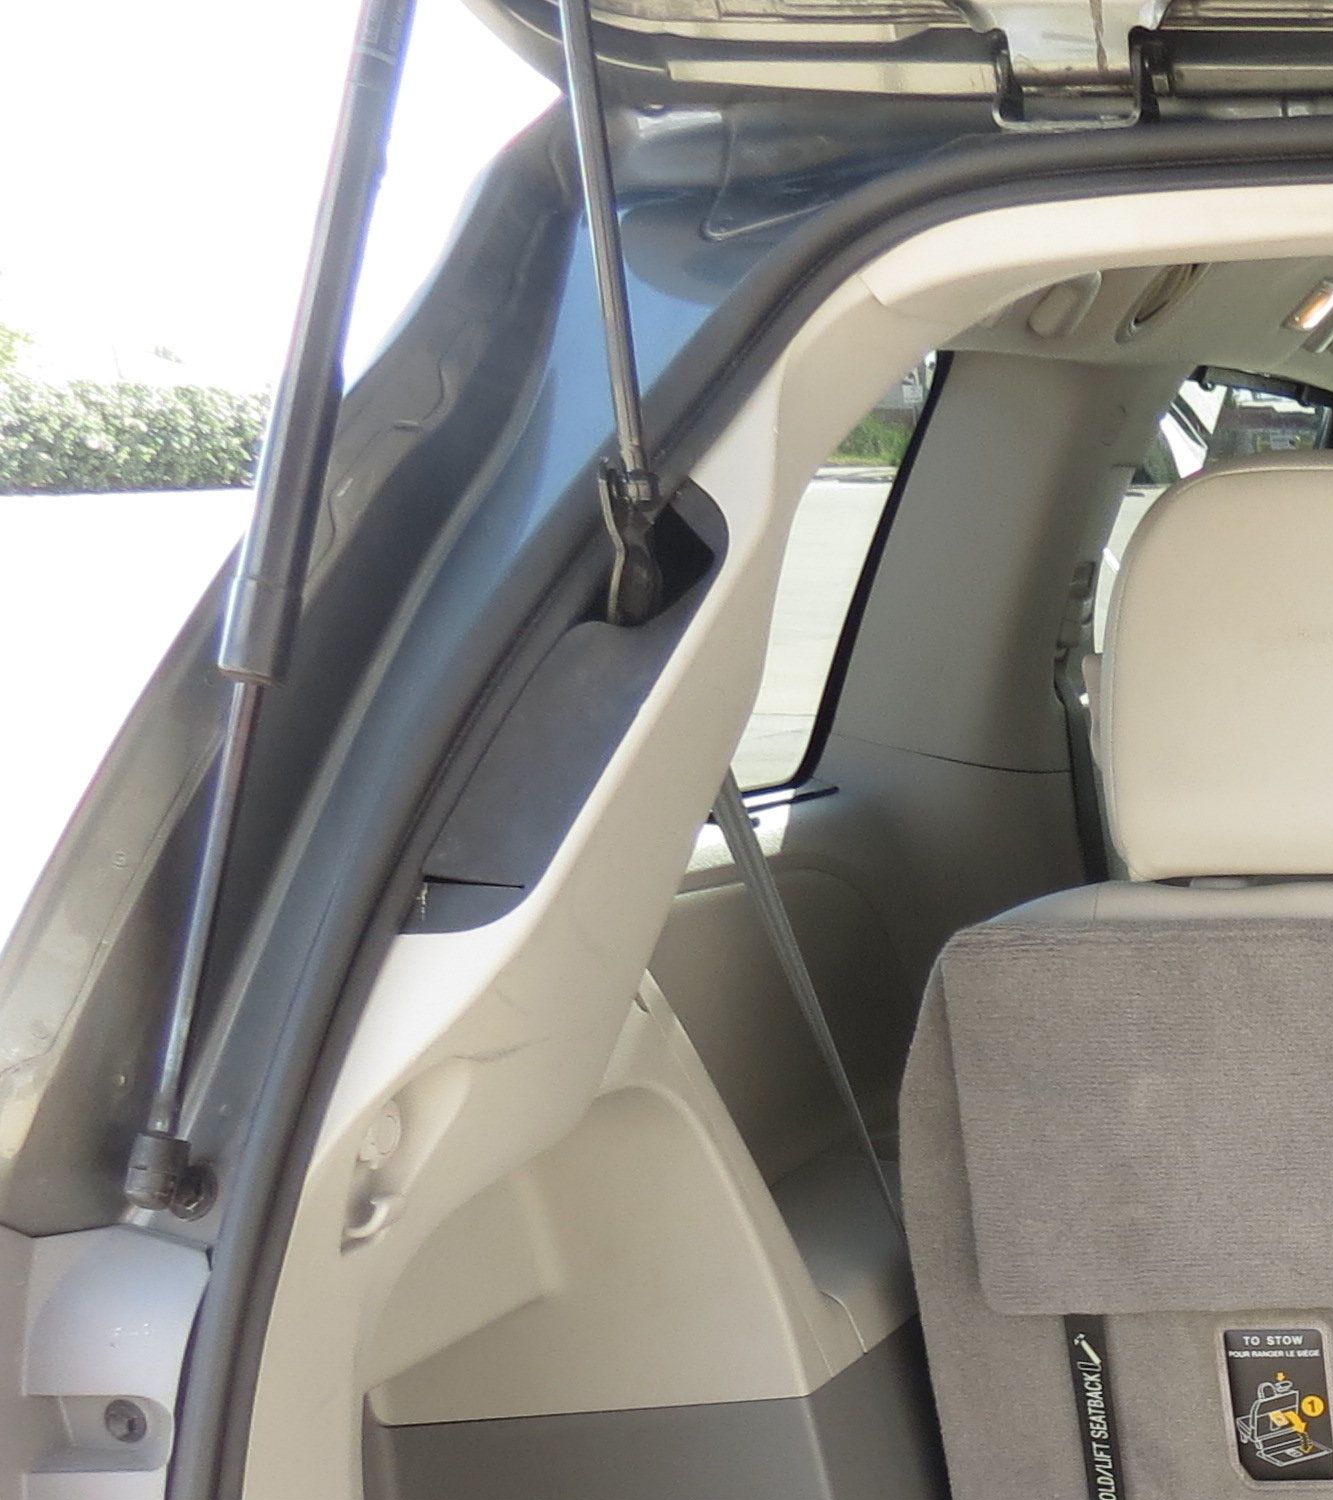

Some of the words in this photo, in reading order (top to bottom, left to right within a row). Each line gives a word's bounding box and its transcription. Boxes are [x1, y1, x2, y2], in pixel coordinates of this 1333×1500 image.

[1242, 1336, 1260, 1346] TO
[1266, 1336, 1304, 1346] STOW
[1286, 1350, 1296, 1358] LE
[1084, 1372, 1109, 1440] SEATBACK
